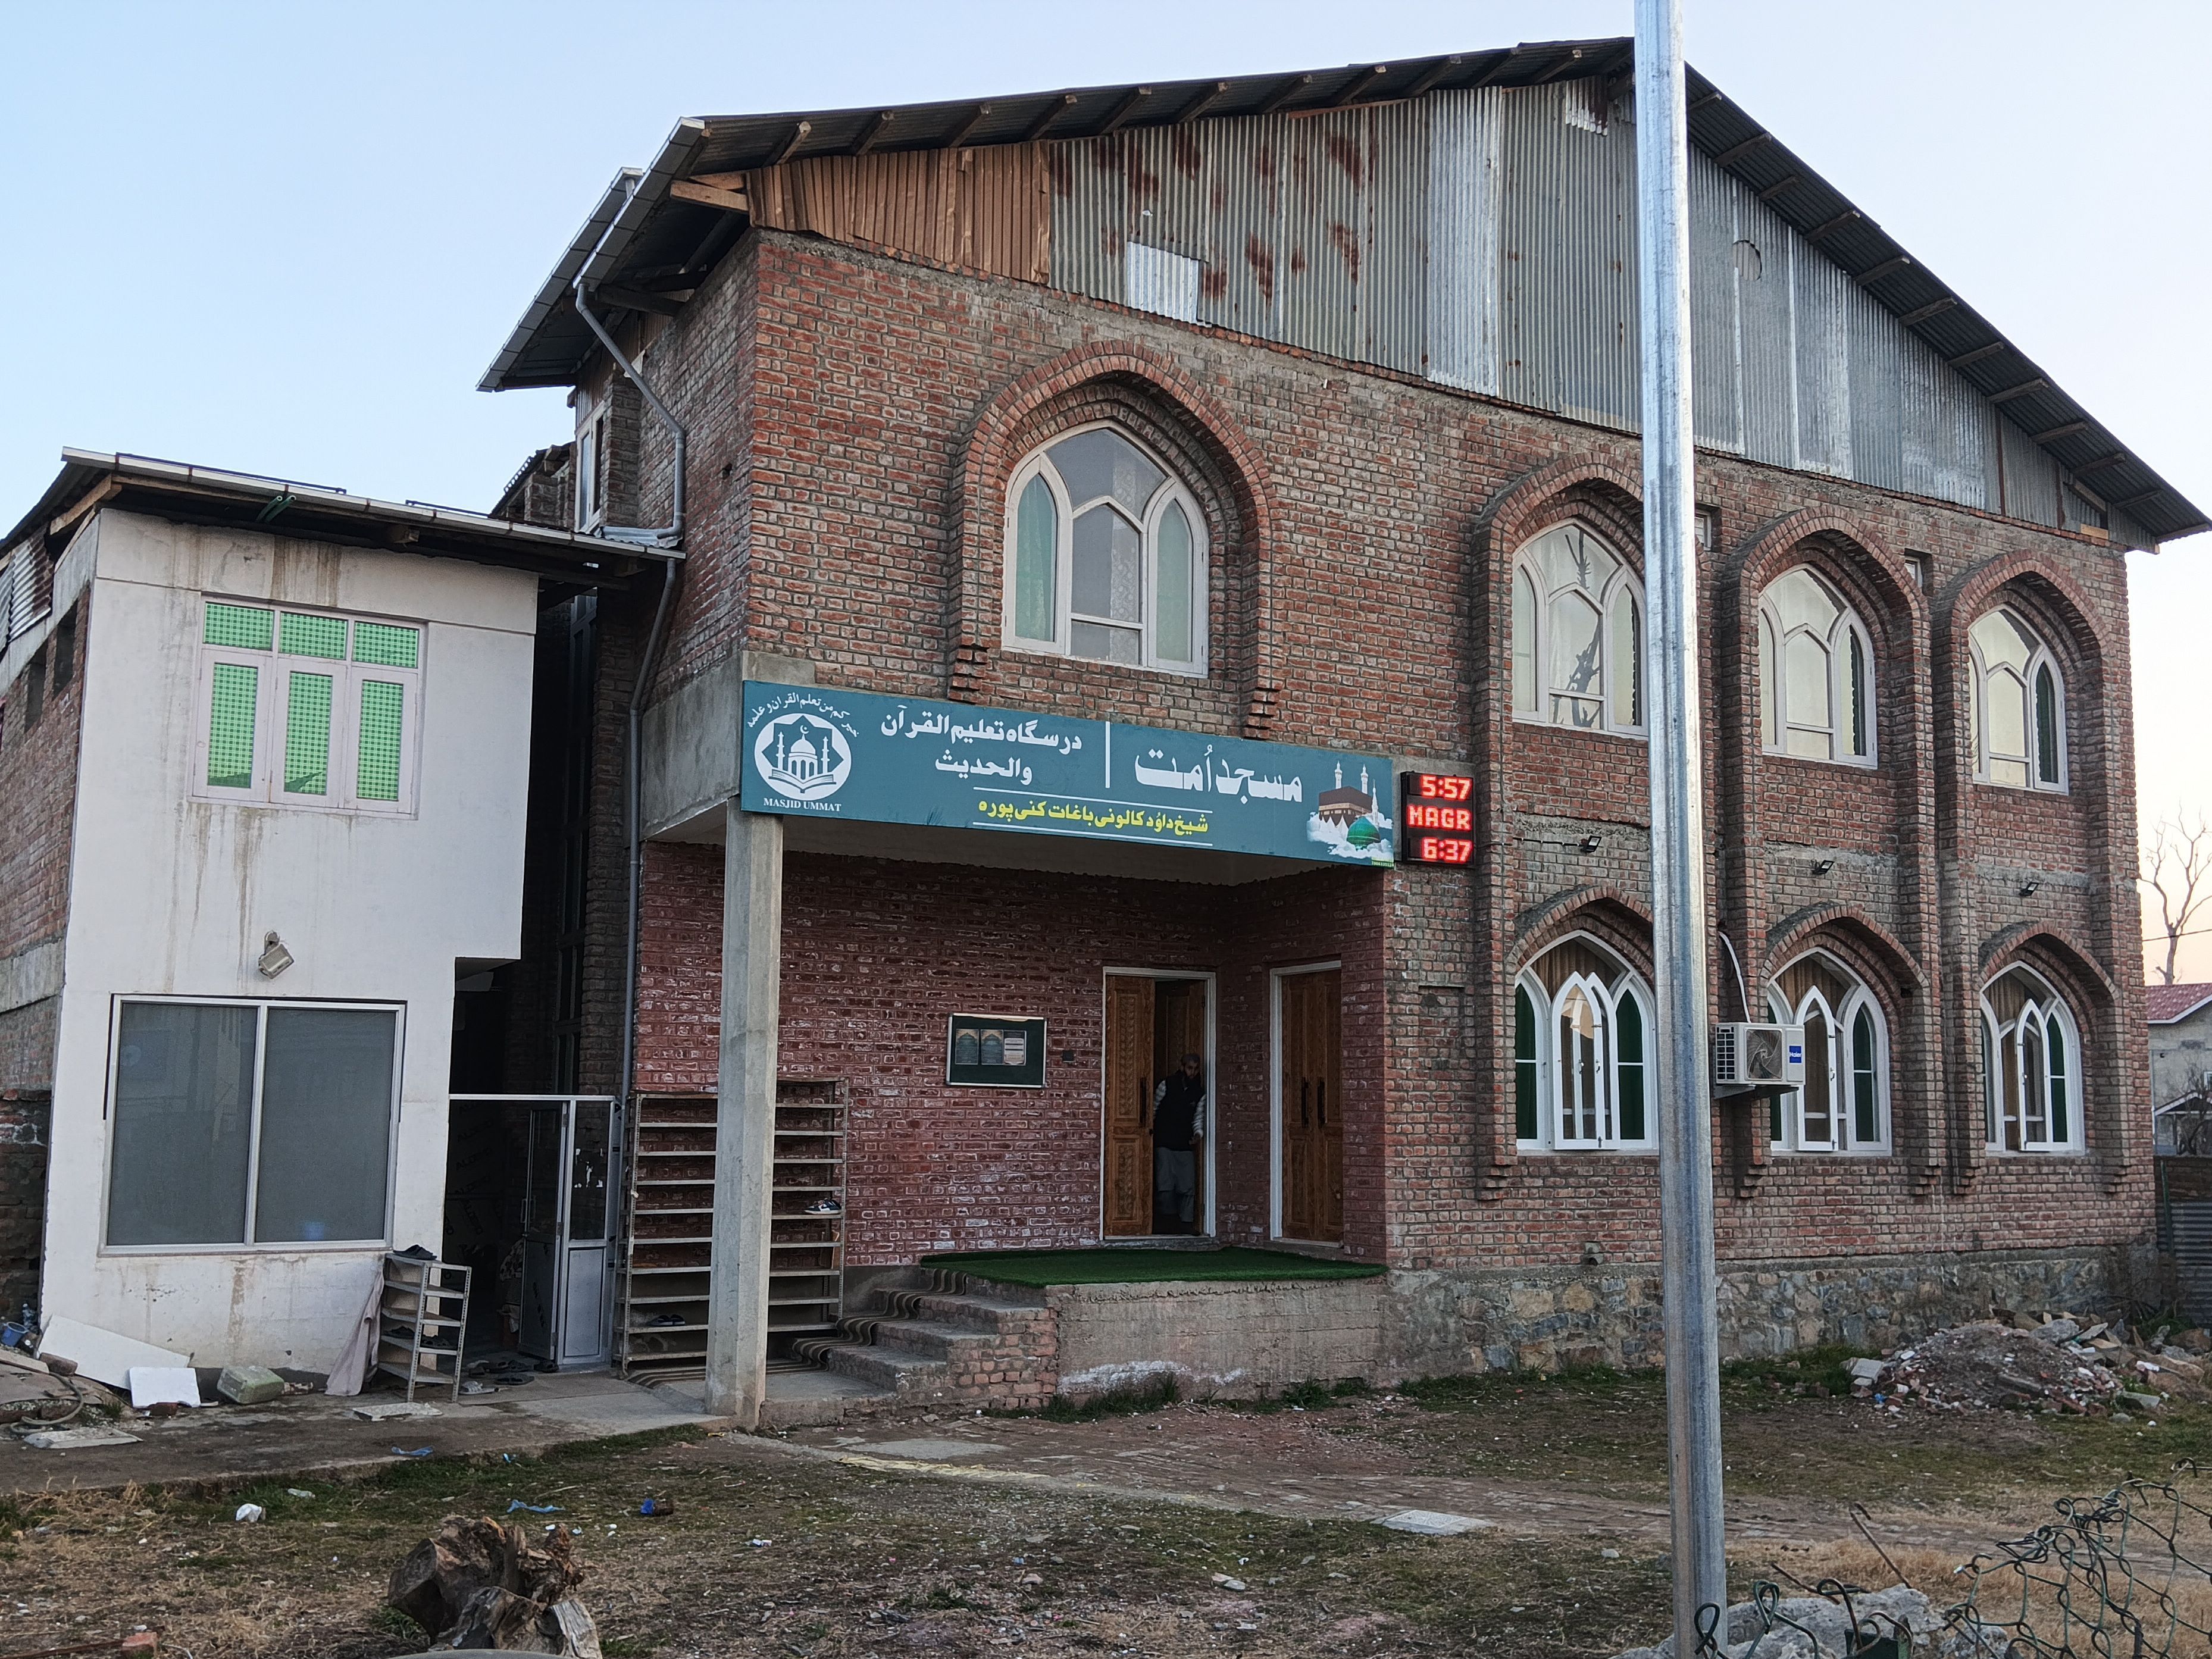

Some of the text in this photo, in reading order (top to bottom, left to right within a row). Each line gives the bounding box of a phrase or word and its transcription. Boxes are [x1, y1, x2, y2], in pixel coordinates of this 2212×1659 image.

[1215, 759, 1302, 805] مسجد
[1421, 775, 1472, 800] 5:57
[763, 797, 842, 812] MASJID UMMAT
[1048, 804, 1094, 827] باغات
[1407, 805, 1472, 831] MAGR
[1422, 837, 1473, 863] 6:37
